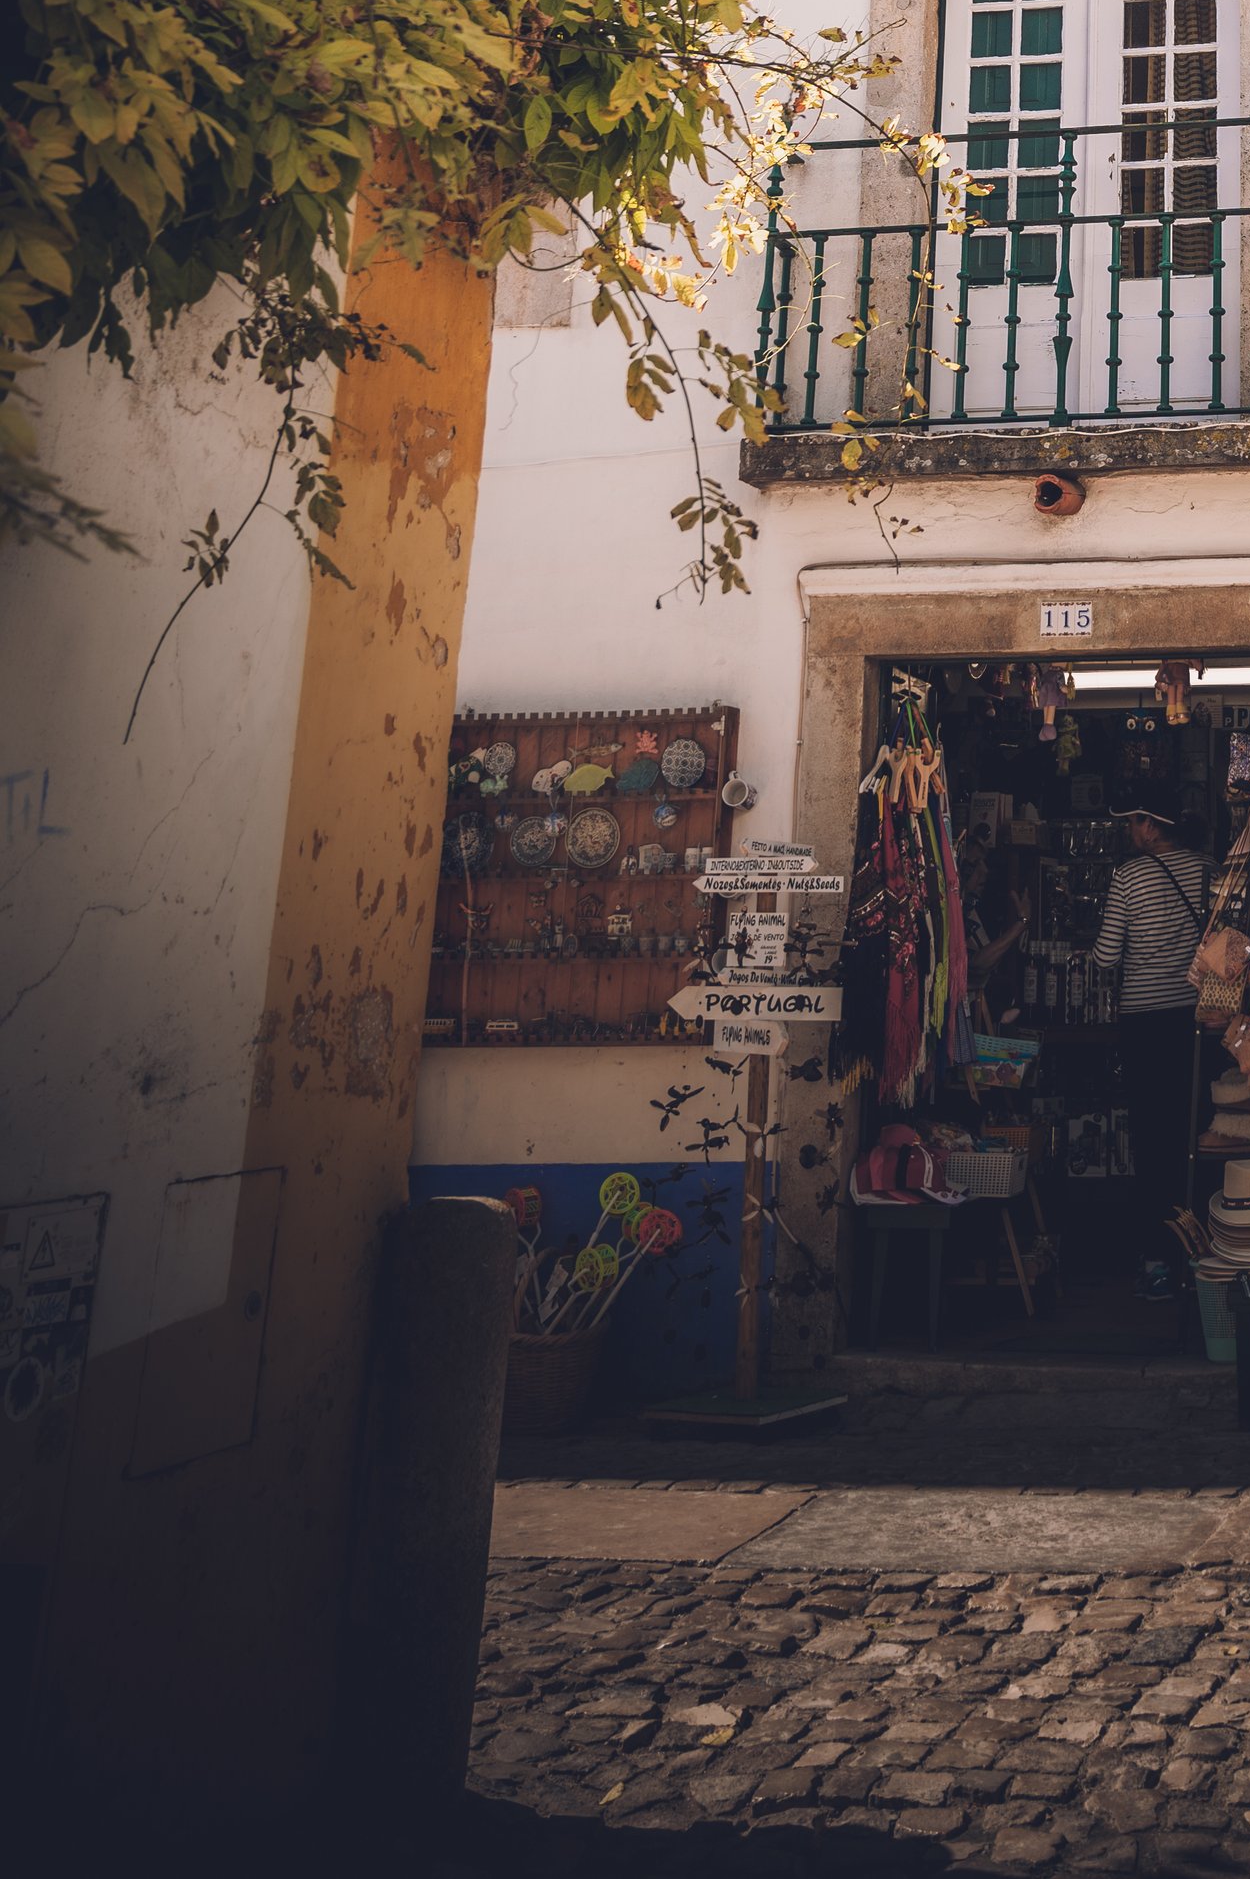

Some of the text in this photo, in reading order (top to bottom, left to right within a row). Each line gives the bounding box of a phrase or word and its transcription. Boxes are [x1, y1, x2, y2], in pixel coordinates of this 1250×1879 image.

[1044, 608, 1090, 628] 115
[751, 841, 768, 852] FEITO
[785, 845, 813, 857] HANDMADE
[704, 877, 841, 891] Nozes&Sementes Nuts&Seeds
[730, 913, 786, 928] FLYING ANIMAL
[753, 933, 762, 941] DE
[763, 933, 785, 941] VENTO
[728, 970, 749, 984] Jogos
[750, 971, 759, 983] De
[705, 994, 825, 1015] PORTUGAL
[721, 1026, 771, 1046] FLYING ANIMALS
